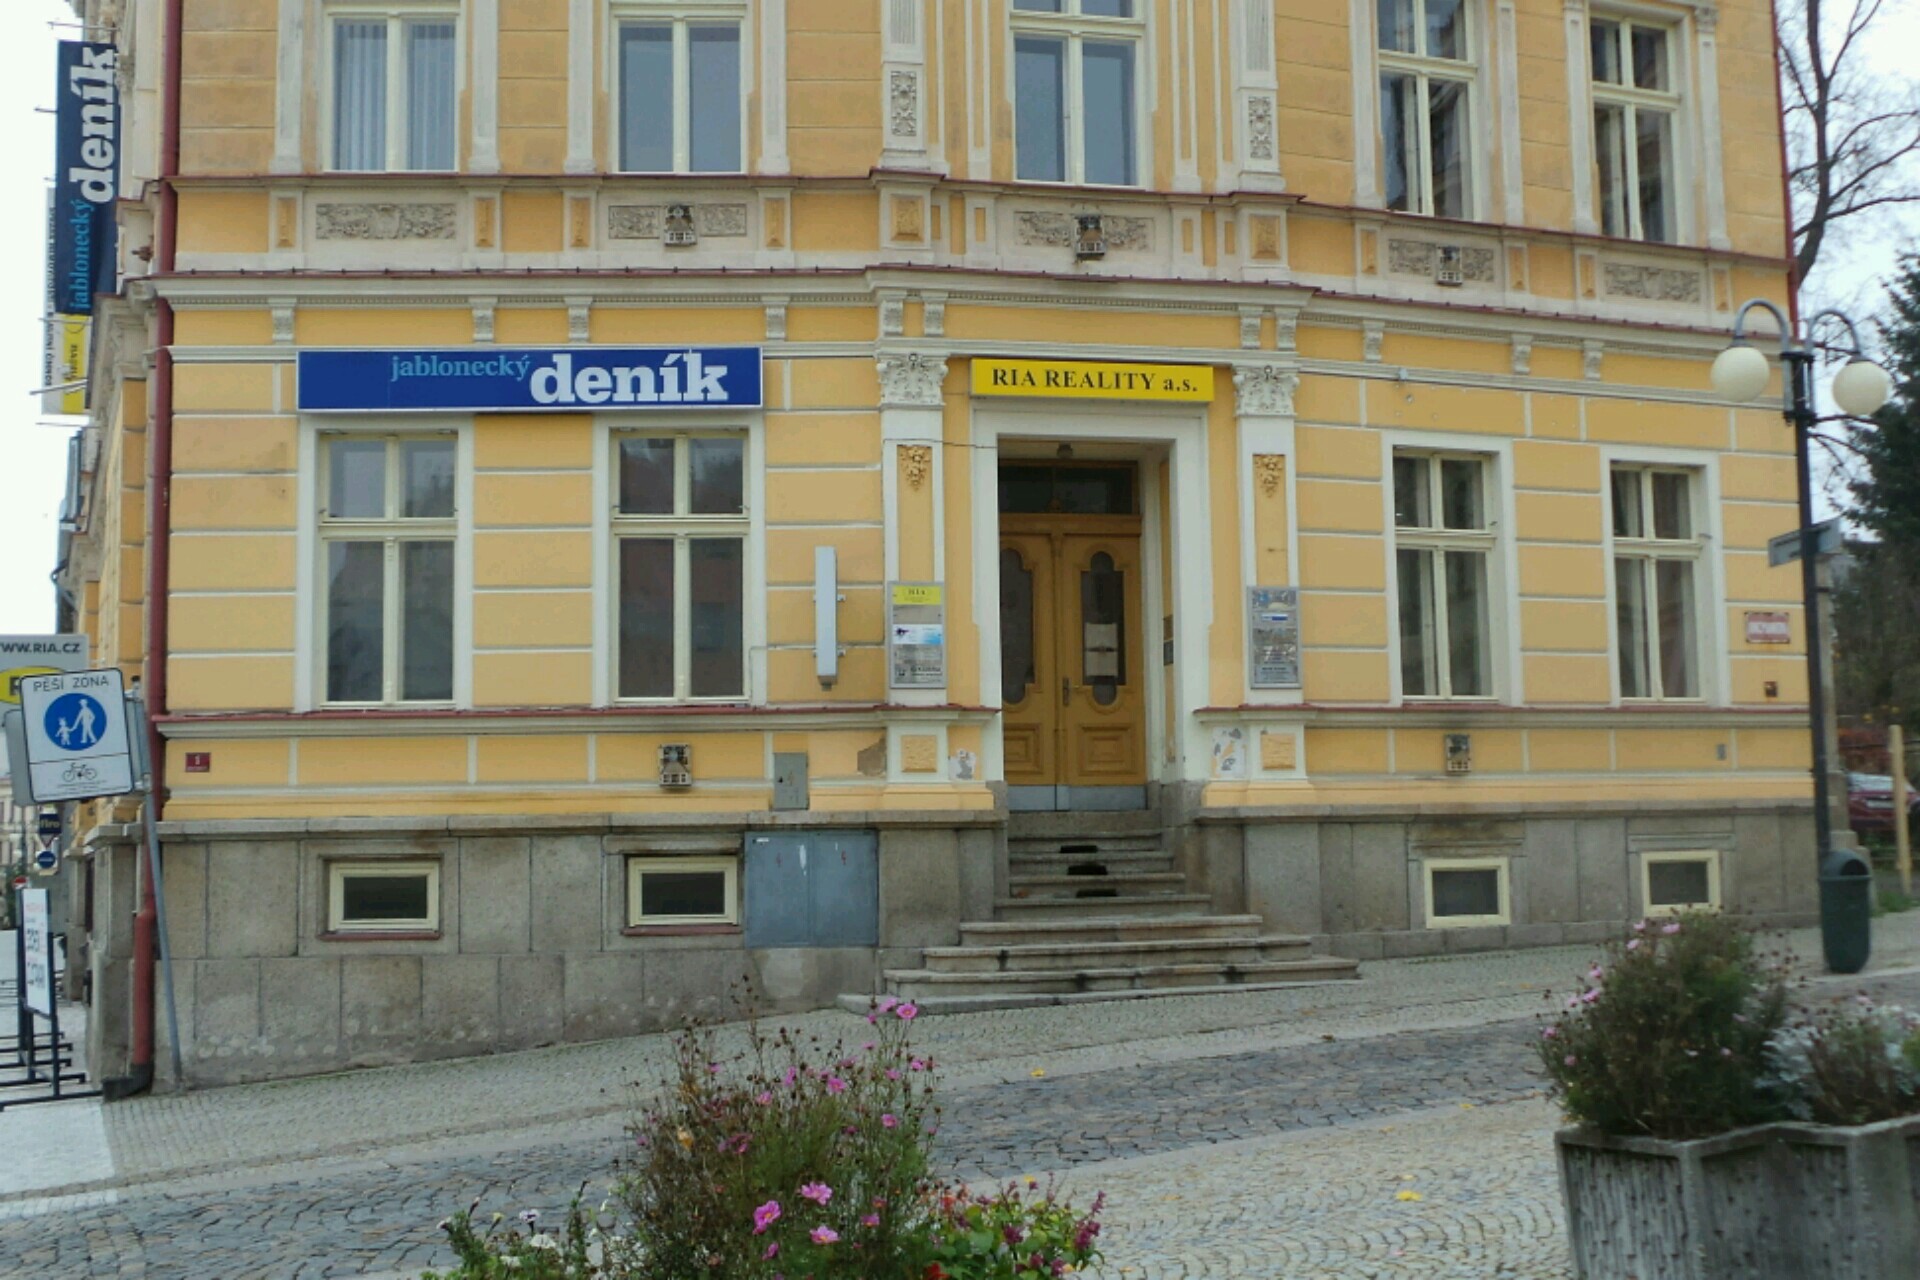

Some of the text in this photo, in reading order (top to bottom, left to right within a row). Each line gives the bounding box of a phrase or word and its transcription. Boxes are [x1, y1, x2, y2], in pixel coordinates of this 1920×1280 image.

[69, 47, 115, 308] jablonecký deník
[391, 352, 729, 403] jablonecký deník
[992, 368, 1198, 391] RIA REALITY a.s.
[0, 642, 81, 654] WW.RIA.CZ
